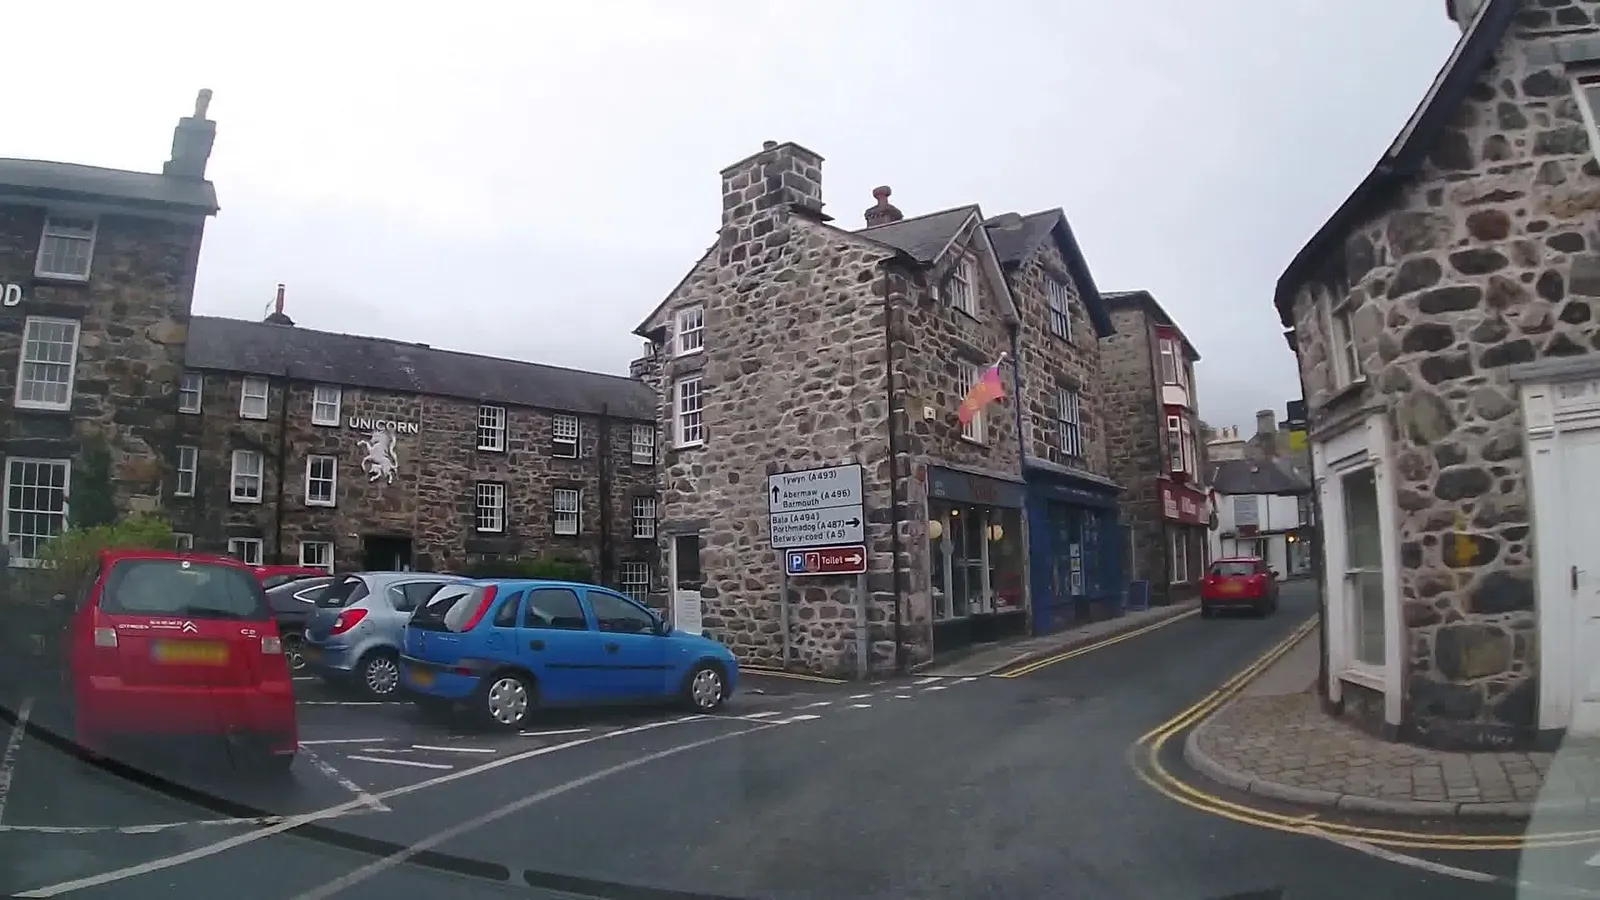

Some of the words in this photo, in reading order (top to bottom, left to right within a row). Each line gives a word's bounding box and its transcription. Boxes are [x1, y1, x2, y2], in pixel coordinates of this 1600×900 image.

[0, 283, 22, 306] D
[349, 416, 419, 434] UNICORN
[783, 476, 806, 485] Tywyn
[783, 490, 818, 499] Abermaw
[783, 498, 820, 508] Barmouth
[772, 516, 788, 524] Bala
[773, 524, 816, 533] Porthmadog
[792, 555, 802, 569] P
[821, 556, 844, 565] Toilet
